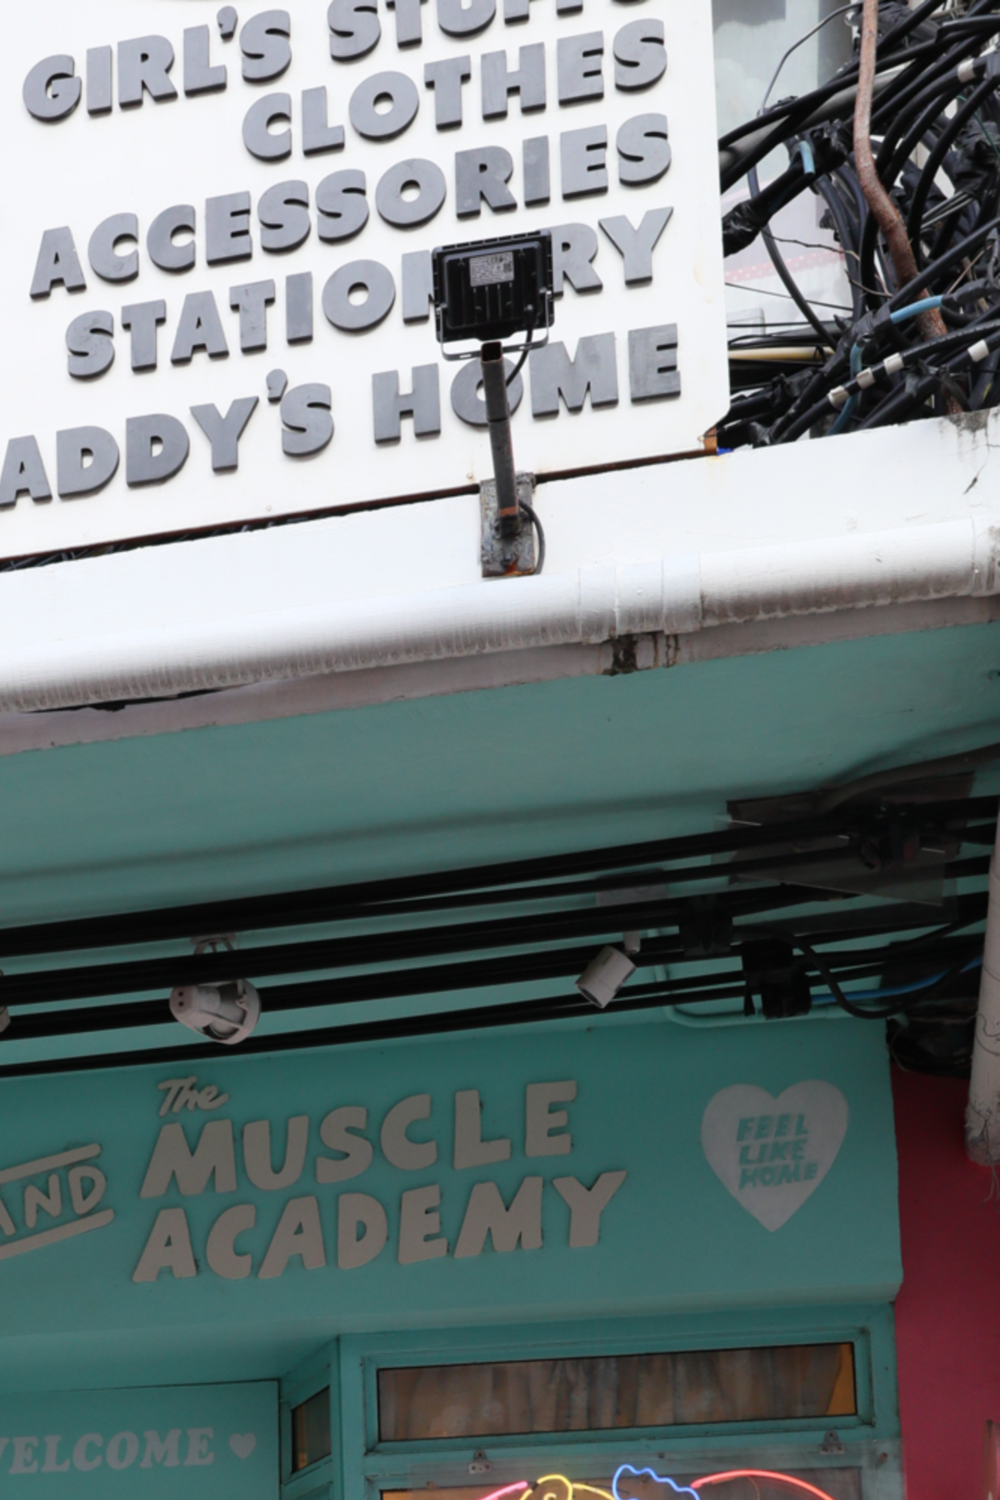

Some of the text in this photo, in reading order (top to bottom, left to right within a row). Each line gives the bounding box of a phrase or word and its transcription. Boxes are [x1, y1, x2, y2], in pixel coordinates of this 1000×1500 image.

[23, 5, 292, 124] GIRL'S
[242, 18, 668, 162] CLOTHES
[30, 112, 672, 300] ACCESSORIES
[66, 205, 675, 380] STATIORY
[372, 322, 682, 445] HOME
[138, 1080, 579, 1202] MUSCLE
[736, 1113, 810, 1142] FEEL
[738, 1138, 809, 1166] LIKE
[738, 1161, 819, 1190] HOME
[131, 1169, 629, 1284] ACADEMY
